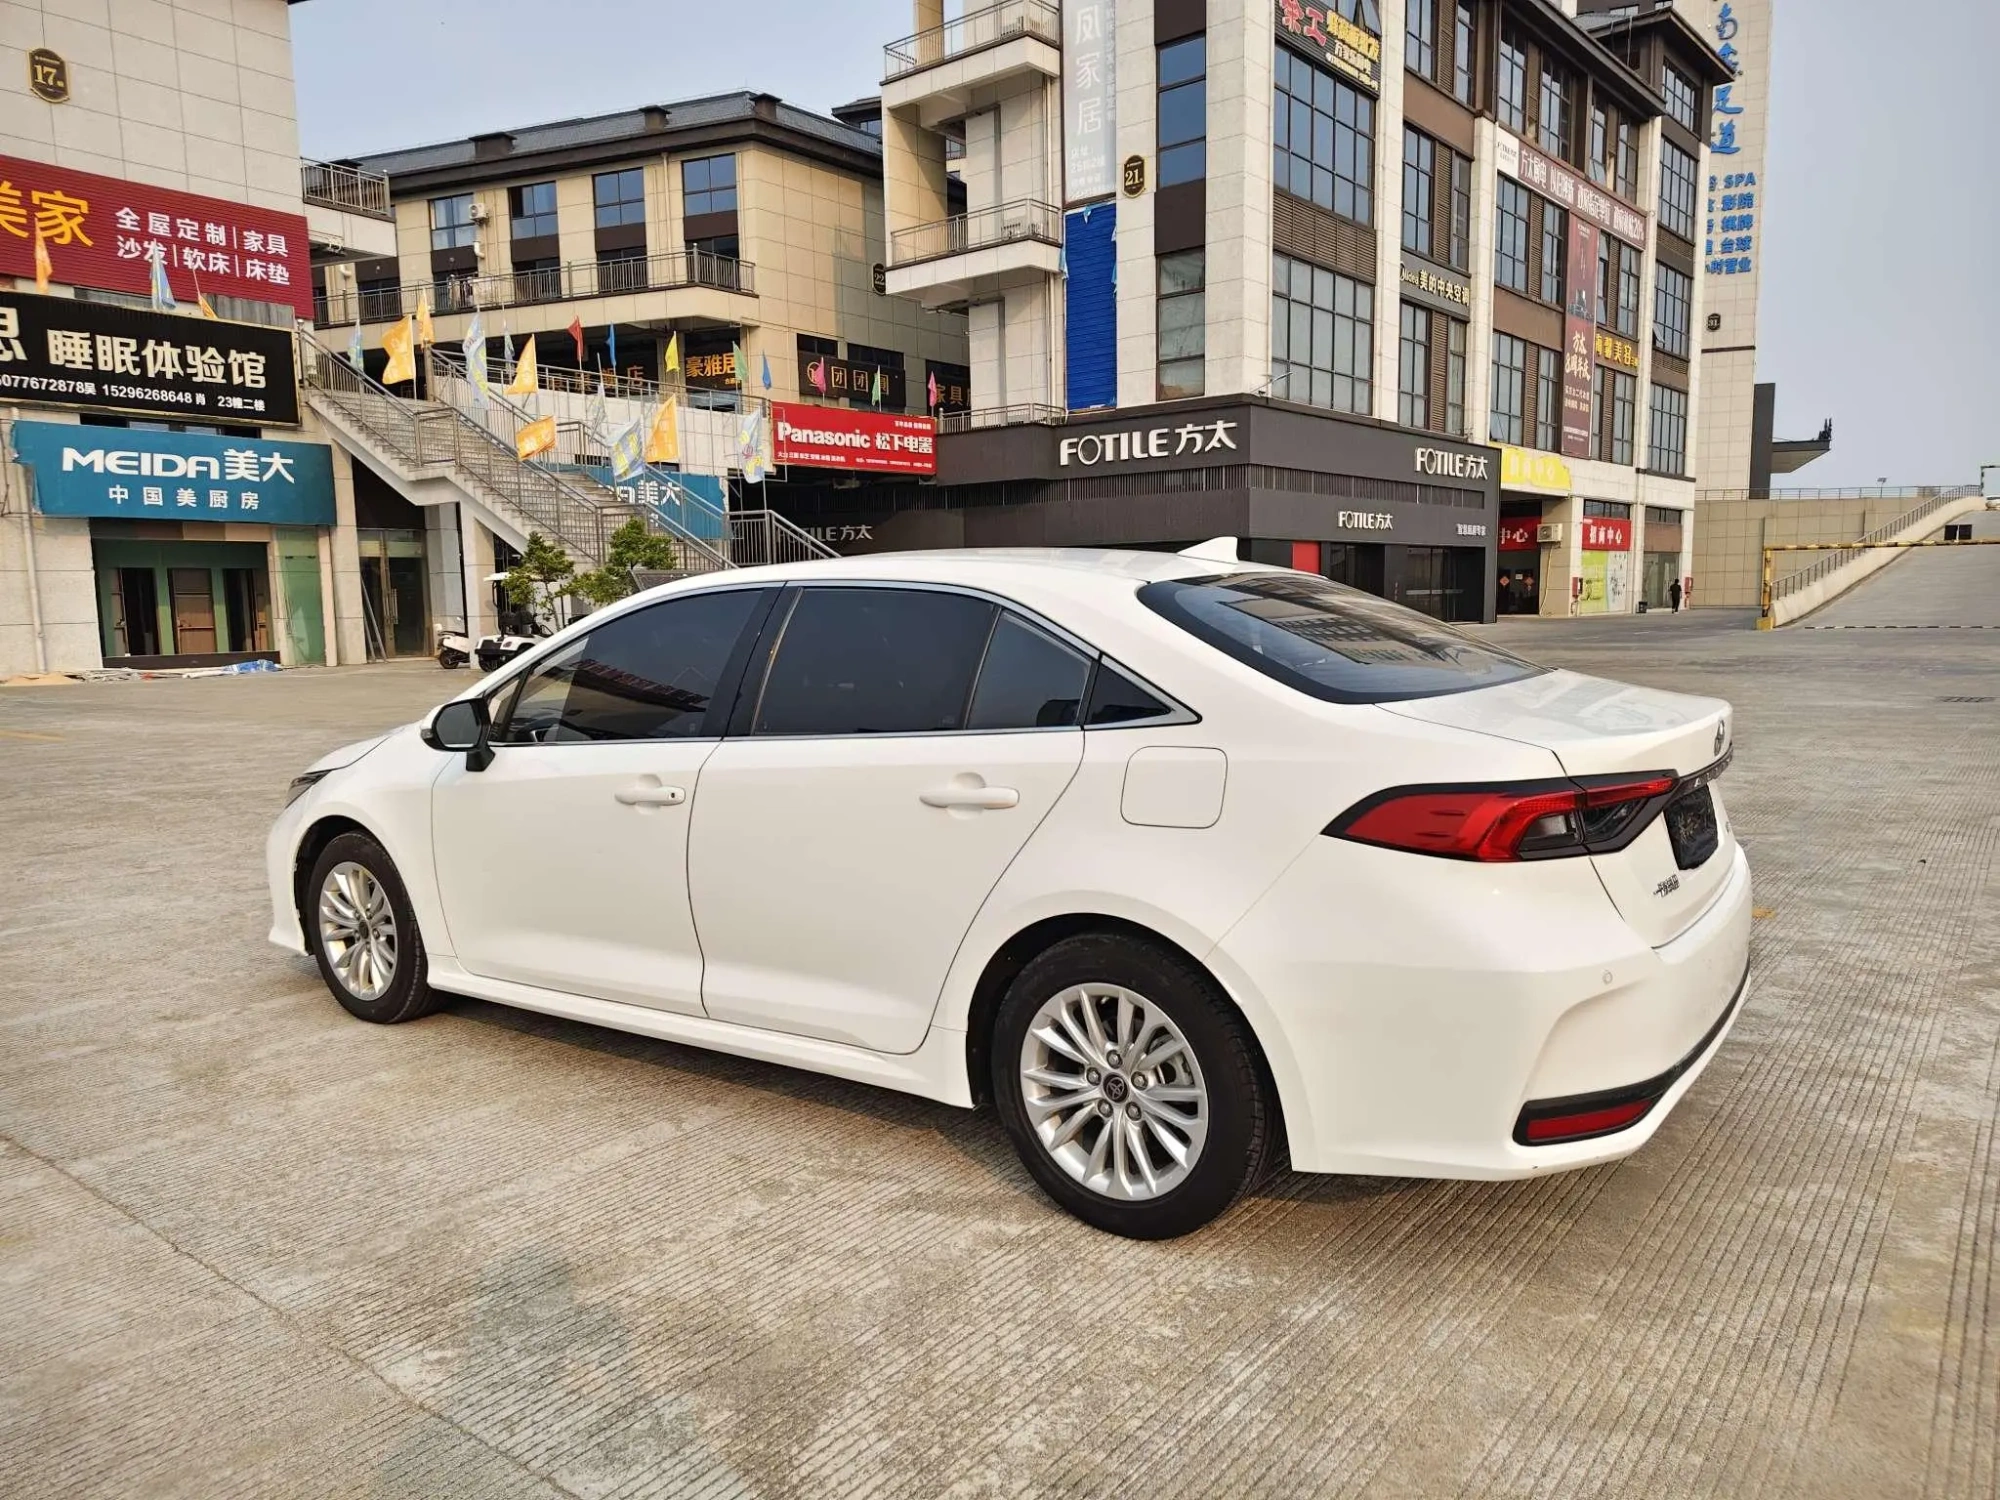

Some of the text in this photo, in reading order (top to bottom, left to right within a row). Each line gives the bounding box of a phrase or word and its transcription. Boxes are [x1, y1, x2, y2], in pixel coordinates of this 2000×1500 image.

[34, 64, 57, 86] 17
[1125, 168, 1140, 186] 21
[1723, 172, 1757, 189] SPA
[115, 206, 289, 258] 全屋定制 家具
[1720, 236, 1752, 255] 台球
[116, 235, 290, 286] 沙发 软床 床垫
[1420, 269, 1470, 307] 美的中央空调
[46, 328, 267, 389] 睡眠体验馆
[0, 373, 97, 396] 077672878吴
[102, 383, 193, 404] 15296268648
[935, 384, 971, 406] 家具
[777, 421, 871, 448] Panasonic
[875, 432, 933, 454] 松下电器
[1060, 419, 1238, 466] FOTILE 方太
[62, 447, 295, 484] MEIDA 美大
[1415, 447, 1488, 480] FOTILE 方太
[108, 484, 260, 510] 中国美厨房
[638, 479, 681, 506] 美大
[840, 525, 873, 541] 方太
[1338, 511, 1394, 530] FOTILE 方太
